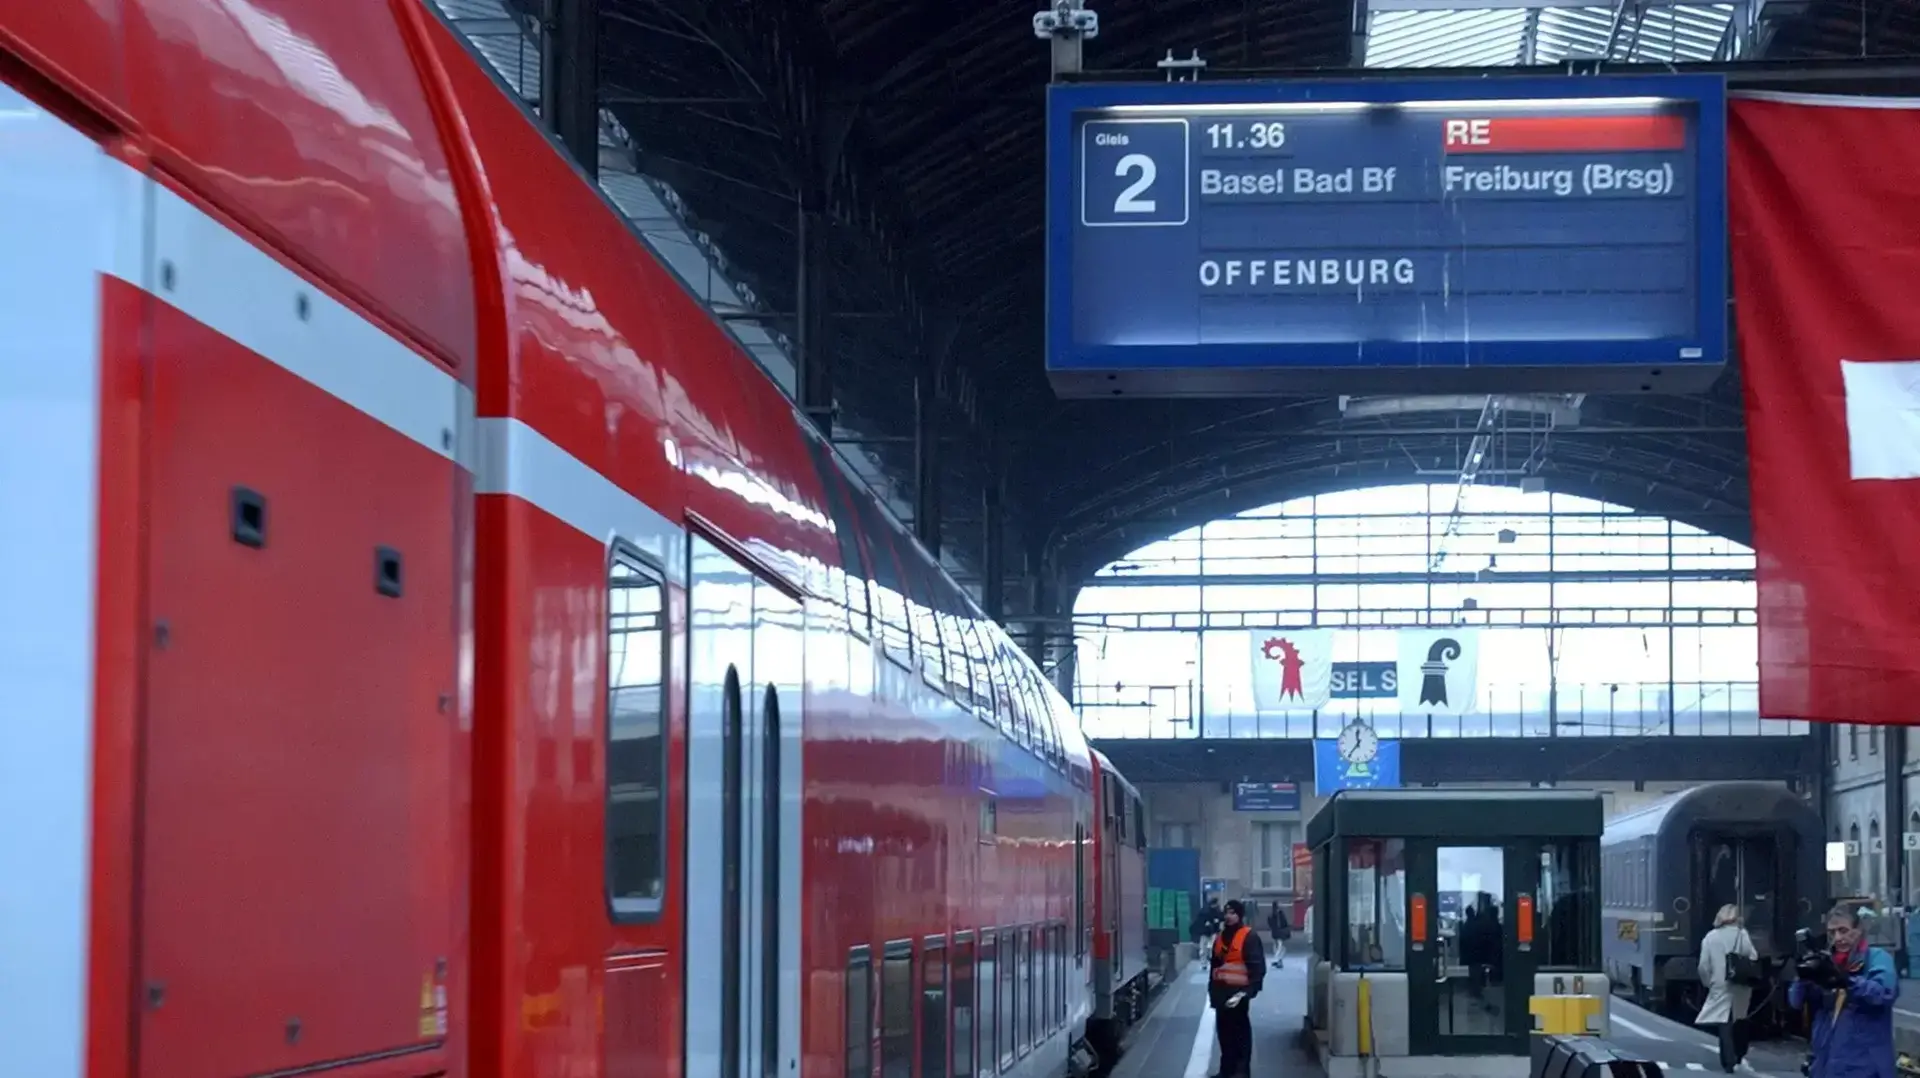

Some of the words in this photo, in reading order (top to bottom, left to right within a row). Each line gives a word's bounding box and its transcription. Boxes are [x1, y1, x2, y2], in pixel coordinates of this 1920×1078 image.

[1095, 133, 1130, 146] Gleis
[1206, 122, 1285, 149] 11.36
[1446, 119, 1491, 145] RE
[1113, 153, 1157, 213] 2
[1201, 168, 1284, 195] Basel
[1293, 168, 1352, 194] Bad
[1362, 166, 1397, 193] Bf
[1445, 165, 1573, 196] Freiburg
[1582, 162, 1674, 196] (Brsg)
[1199, 258, 1414, 286] OFFENBURG
[1908, 834, 1917, 847] 5
